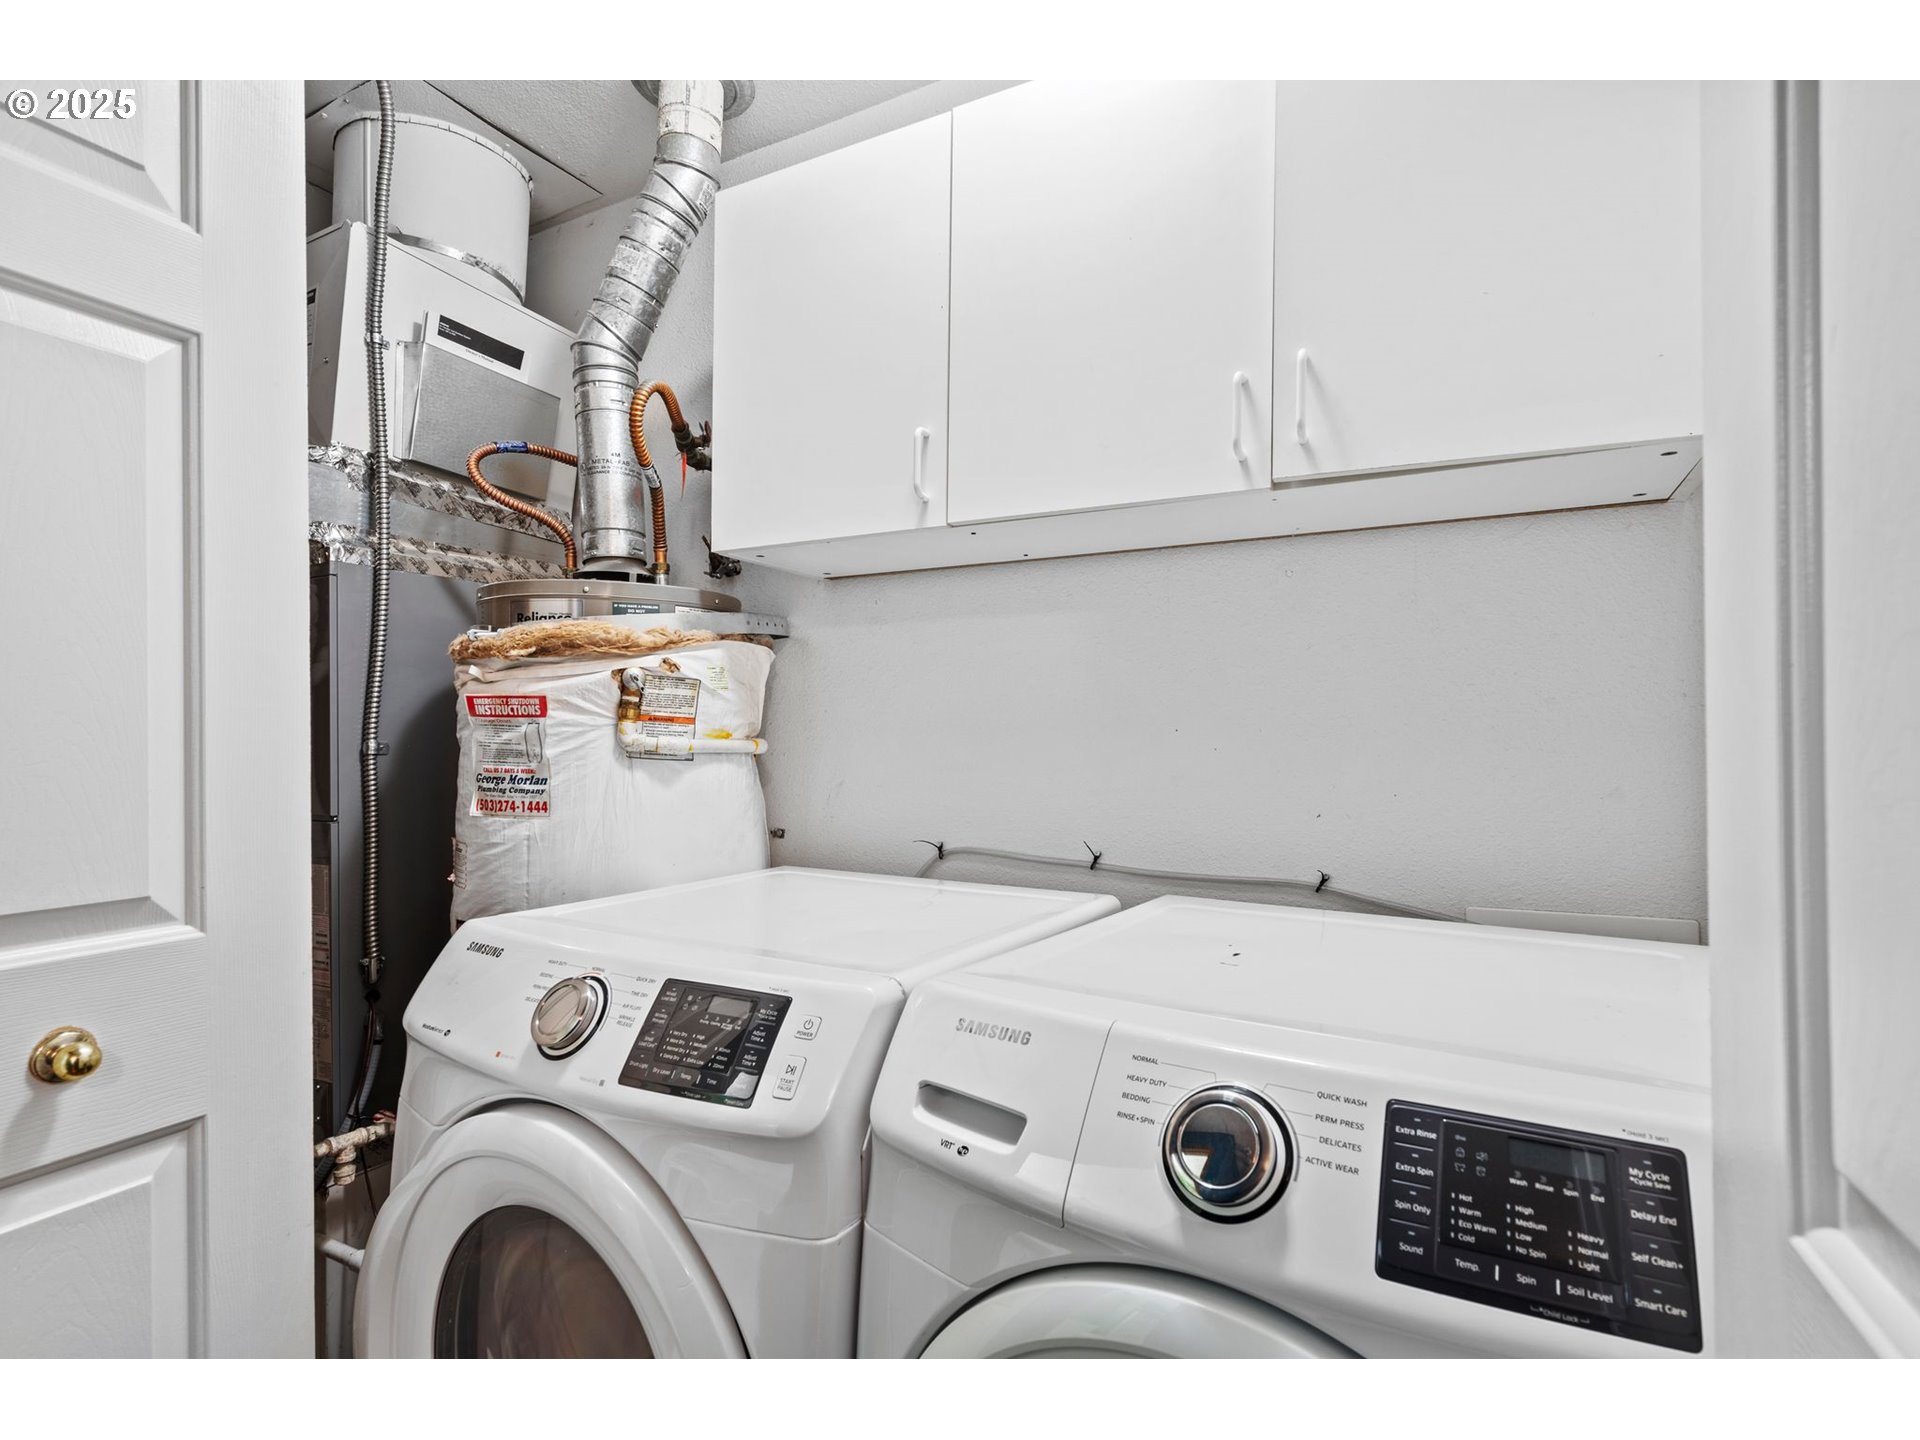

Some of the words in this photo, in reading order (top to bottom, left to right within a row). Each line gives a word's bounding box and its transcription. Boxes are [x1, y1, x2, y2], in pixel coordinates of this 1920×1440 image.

[475, 705, 541, 715] INSTRUCTIONS
[476, 773, 506, 786] George
[507, 775, 548, 785] Morlan
[477, 785, 507, 794] Plumbing
[508, 787, 546, 795] Company
[476, 799, 548, 813] (503)274-1444
[466, 941, 504, 958] SAMSUNG
[955, 1017, 1032, 1046] SAMSUNG
[1131, 1054, 1160, 1065] NORMAL
[652, 1067, 661, 1075] Dry
[1126, 1074, 1148, 1083] HEAVY
[1149, 1078, 1168, 1087] DUTY
[1121, 1091, 1151, 1104] BEDDING
[1316, 1091, 1341, 1102] QUICK
[1343, 1096, 1368, 1107] WASH
[1315, 1113, 1338, 1124] PERM
[1340, 1119, 1365, 1131] PRESS
[1395, 1125, 1415, 1136] Extra
[1416, 1129, 1438, 1140] Rinse
[1318, 1136, 1362, 1152] DELICATES
[1305, 1156, 1333, 1169] ACTIVE
[1335, 1163, 1360, 1175] WEAR
[1395, 1162, 1415, 1173] Extra
[1416, 1166, 1434, 1177] Spin
[1628, 1167, 1644, 1179] My
[1645, 1170, 1670, 1183] Cycle
[1509, 1177, 1528, 1187] Wash
[1534, 1182, 1554, 1193] Rinse
[1654, 1181, 1671, 1191] Save
[1458, 1194, 1473, 1203] Hot
[1563, 1188, 1580, 1198] Spin
[1590, 1193, 1605, 1203] End
[1394, 1199, 1411, 1211] Spin
[1412, 1204, 1431, 1216] Only
[1458, 1206, 1482, 1218] Warm
[1515, 1205, 1534, 1216] High
[1630, 1209, 1657, 1223] Delay
[1658, 1215, 1678, 1227] End
[1458, 1219, 1473, 1229] Eco
[1473, 1223, 1497, 1235] Warm
[1515, 1218, 1548, 1232] Medium
[1457, 1232, 1476, 1244] Cold
[1515, 1232, 1532, 1242] Low
[1577, 1232, 1605, 1246] Heavy
[1399, 1242, 1424, 1255] Sound
[1515, 1246, 1528, 1256] No
[1529, 1249, 1547, 1260] Spin
[1577, 1246, 1609, 1260] Normal
[1631, 1251, 1650, 1263] Self
[1455, 1257, 1480, 1272] Temp.
[1578, 1260, 1601, 1272] Light
[1516, 1273, 1537, 1286] Spin
[1567, 1285, 1585, 1298] Soil
[1587, 1290, 1613, 1304] Level
[1634, 1298, 1663, 1313] Smart
[1664, 1304, 1688, 1318] Care
[1562, 1314, 1579, 1323] Lock
